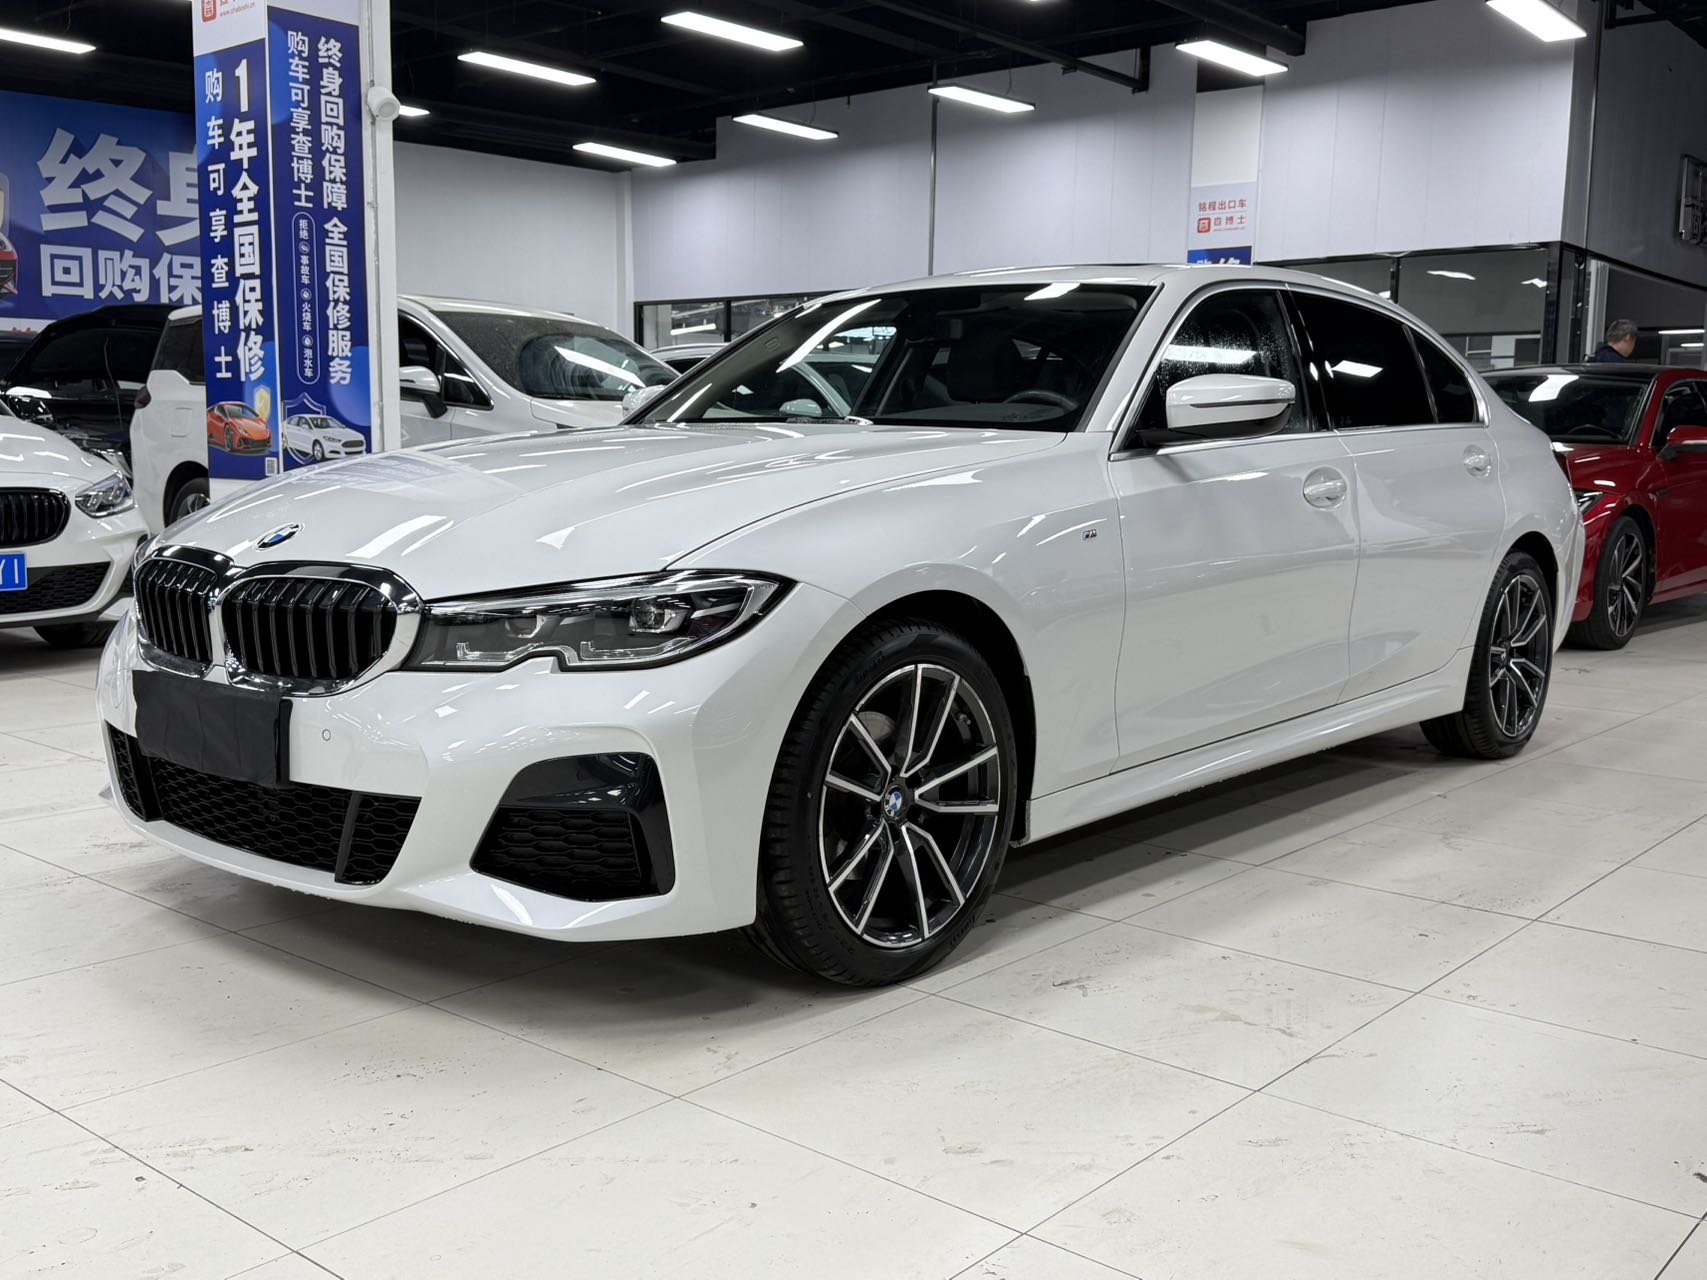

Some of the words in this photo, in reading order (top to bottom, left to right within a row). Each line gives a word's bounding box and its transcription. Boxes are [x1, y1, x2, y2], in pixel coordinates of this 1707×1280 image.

[287, 31, 314, 208] 购车可享查博士
[317, 36, 347, 211] 终身回购保障
[40, 244, 202, 305] 回购保
[205, 68, 232, 378] 购车可享查博士
[230, 59, 264, 382] 1年全国保修
[300, 255, 311, 285] 事故车
[324, 217, 352, 385] 全国保修服务
[303, 348, 314, 378] 泡水车
